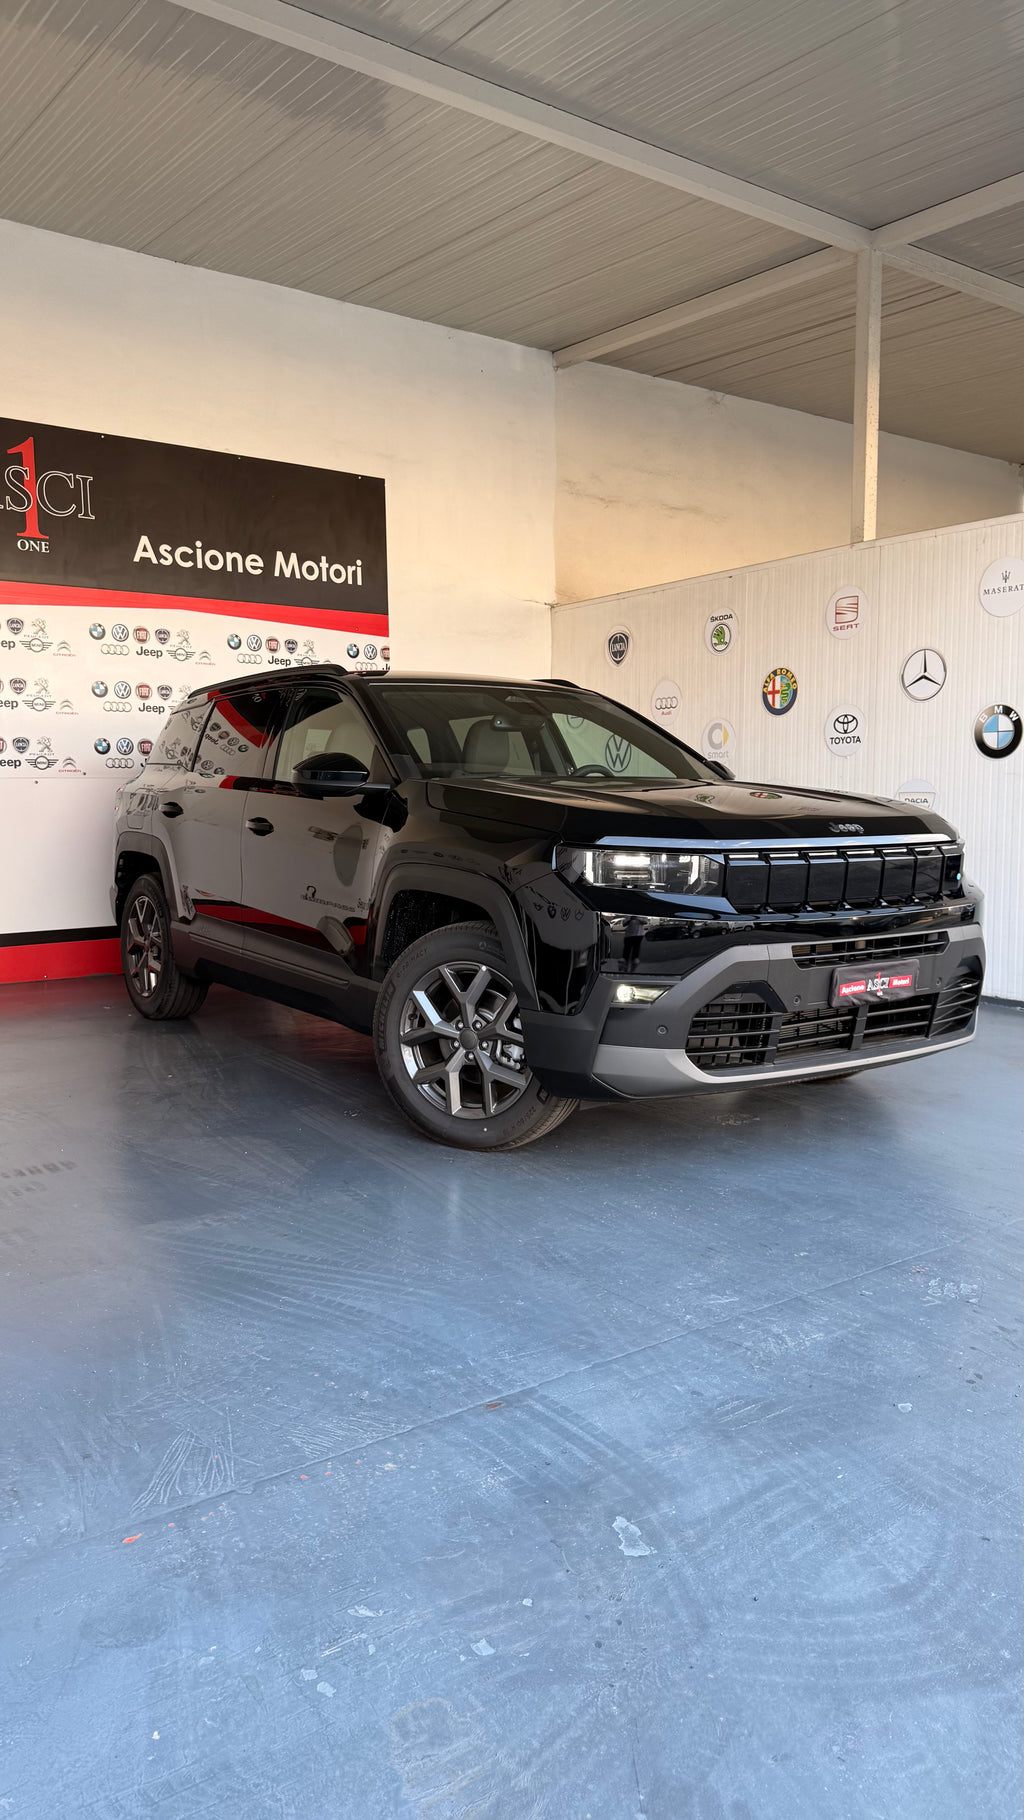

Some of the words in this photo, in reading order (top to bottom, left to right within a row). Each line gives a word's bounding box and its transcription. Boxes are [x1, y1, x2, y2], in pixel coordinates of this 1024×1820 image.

[0, 465, 95, 520] SCI
[17, 539, 50, 553] ONE
[133, 535, 264, 575] Ascione
[274, 551, 363, 586] Motori
[983, 584, 1024, 595] MASERAT
[832, 623, 860, 632] SEAT
[0, 639, 16, 650] ep
[136, 646, 163, 659] Jeep
[268, 655, 291, 667] Jeep
[0, 700, 18, 710] ep
[138, 702, 165, 715] Jeep
[979, 705, 1019, 724] BMW
[830, 736, 862, 745] TOYOTA
[707, 750, 729, 759] smart
[0, 759, 21, 769] eep
[829, 822, 864, 834] Jeep
[841, 985, 865, 994] Ascione
[866, 977, 889, 991] ASCI
